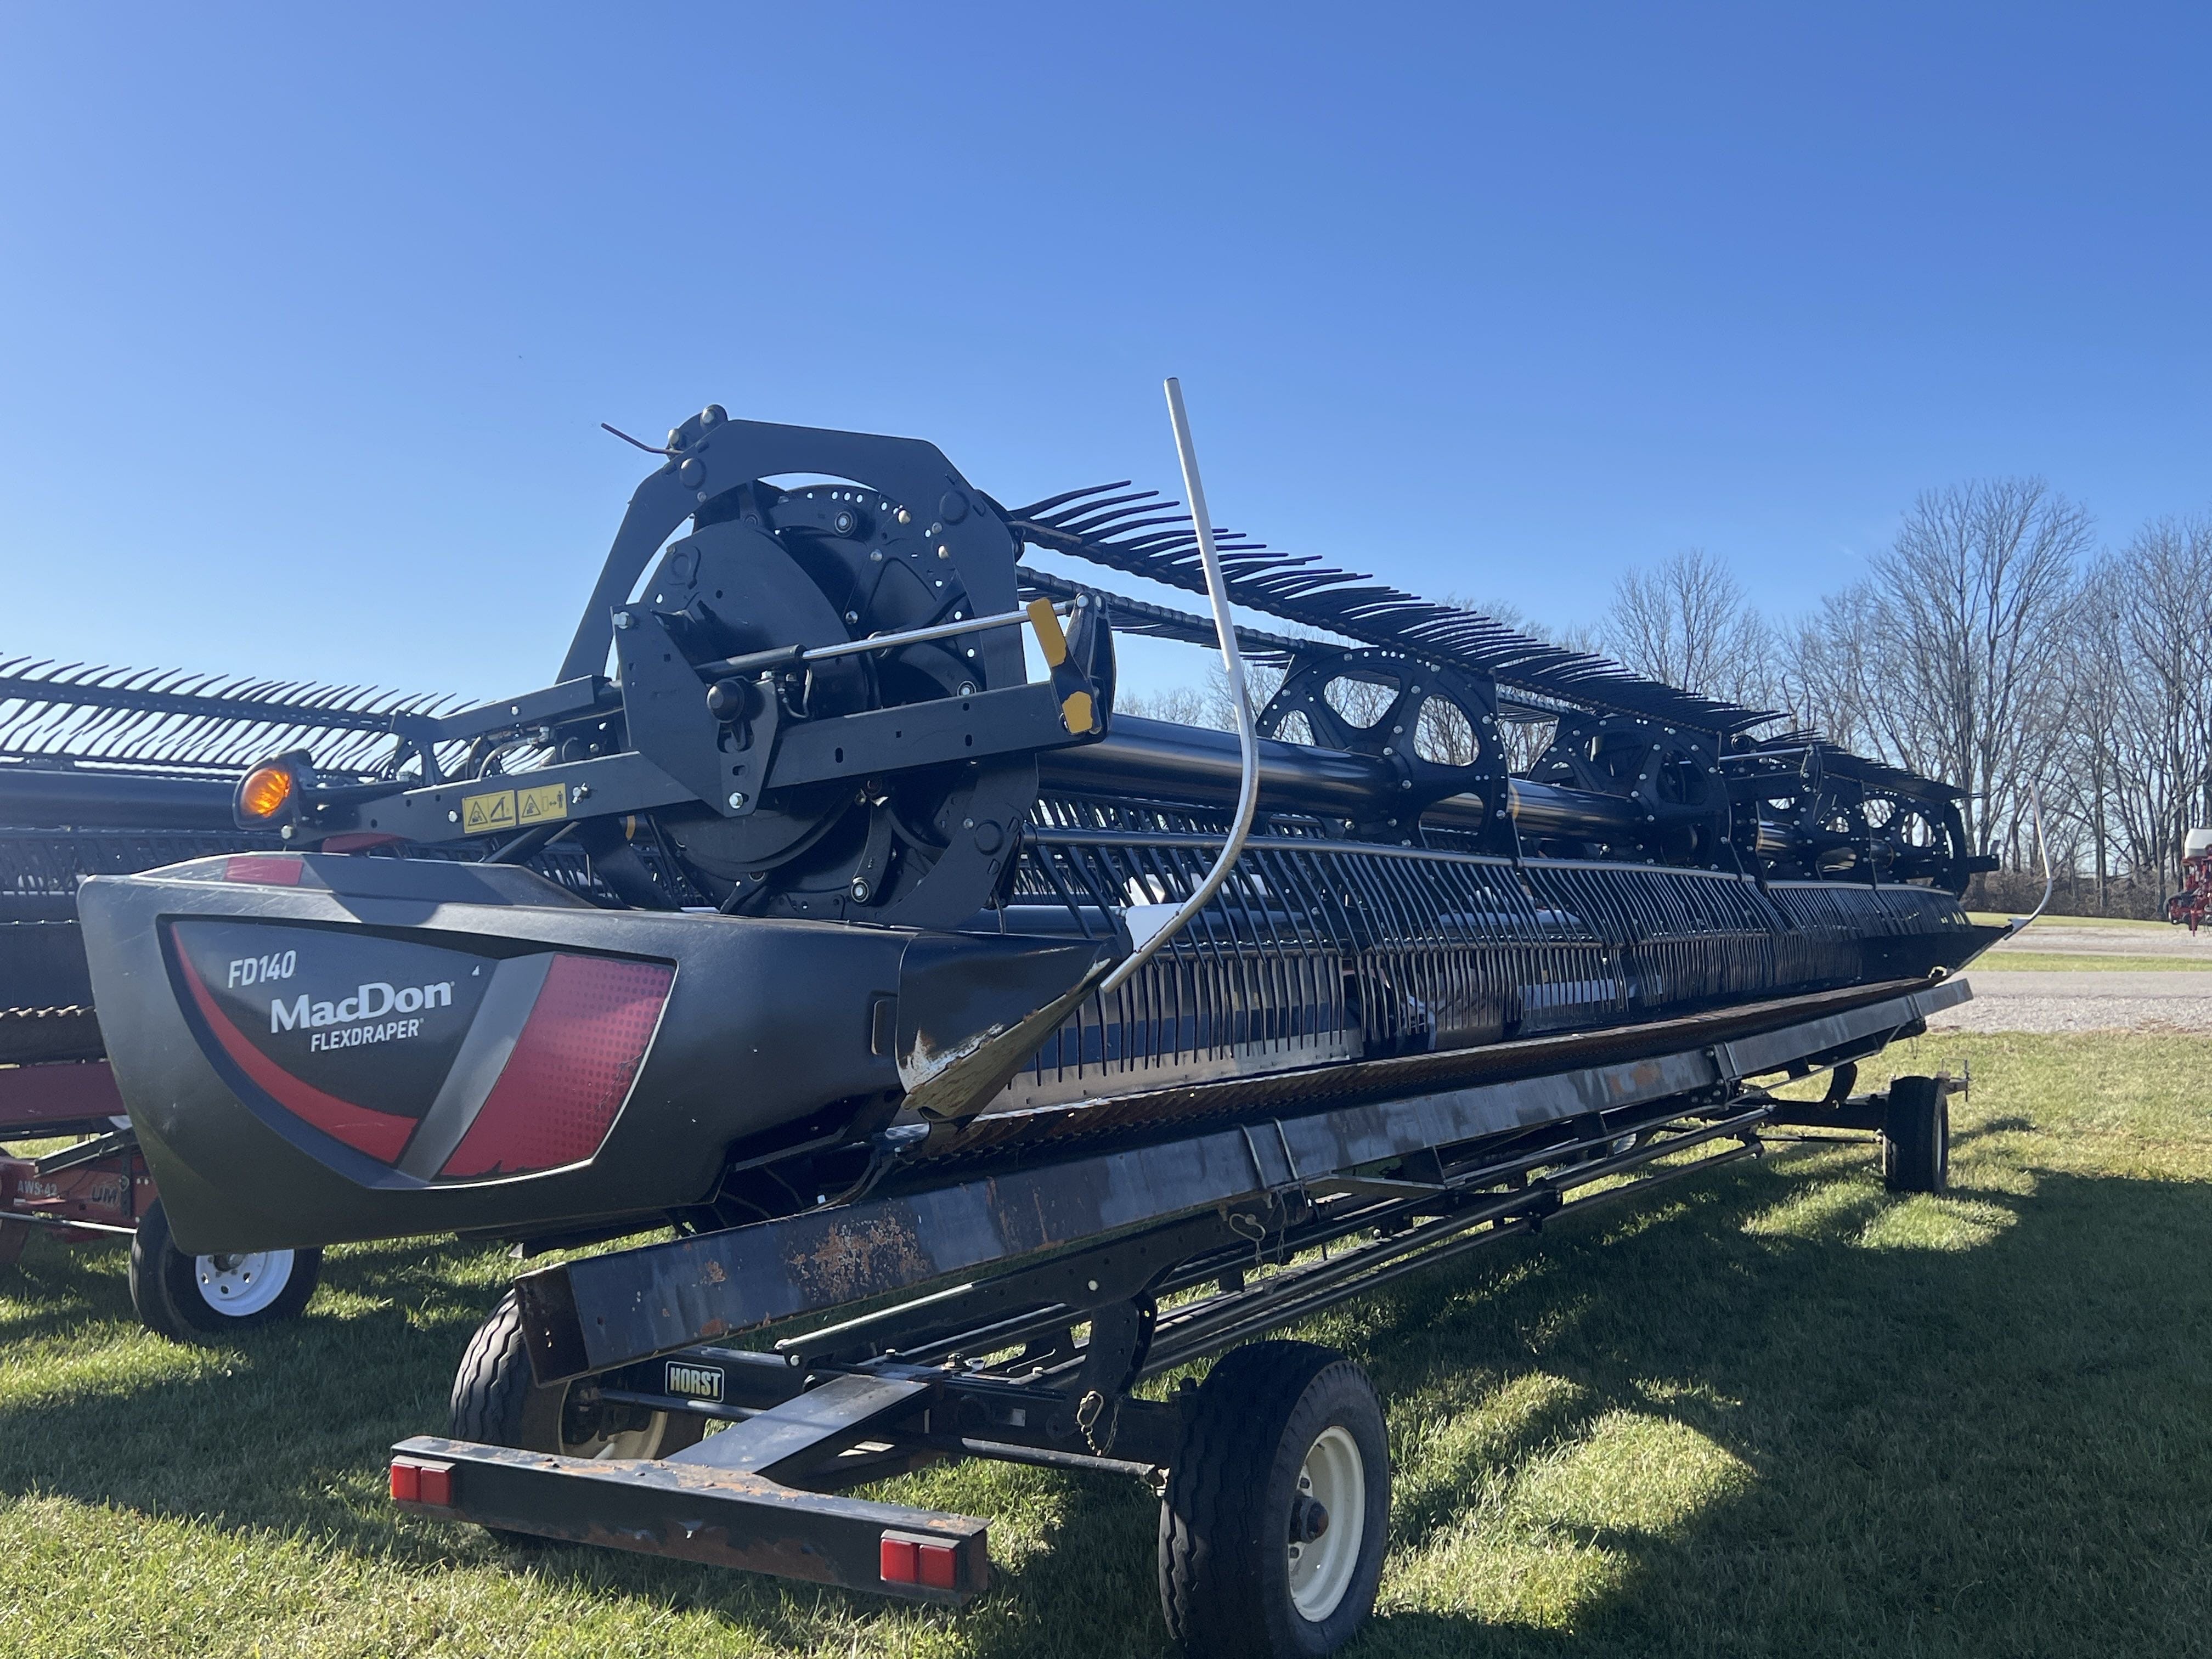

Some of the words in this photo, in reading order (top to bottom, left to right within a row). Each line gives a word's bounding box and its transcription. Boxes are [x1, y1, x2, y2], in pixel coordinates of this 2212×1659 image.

[228, 950, 296, 988] FD140
[271, 982, 452, 1034] MacDon
[311, 1019, 419, 1052] FLEXDRAPER
[670, 1367, 721, 1397] HORST
